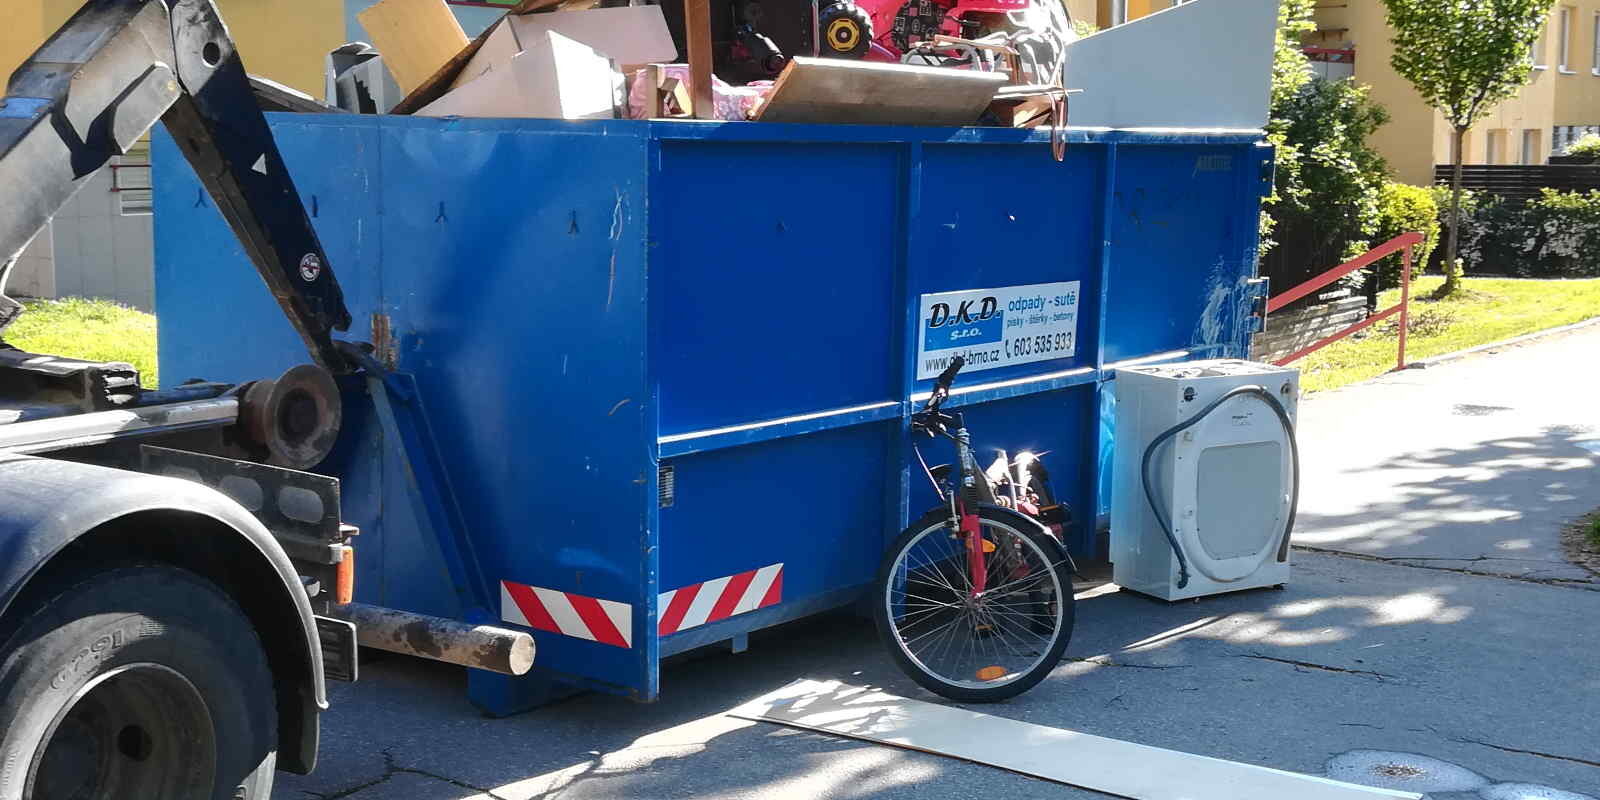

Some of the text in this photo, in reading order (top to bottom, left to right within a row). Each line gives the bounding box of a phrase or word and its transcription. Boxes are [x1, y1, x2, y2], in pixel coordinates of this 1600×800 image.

[930, 296, 1000, 328] D.K.D.
[1008, 294, 1045, 314] odpady
[1054, 290, 1075, 306] sutě
[950, 328, 982, 340] s.r.o.
[1014, 332, 1071, 356] 603 535 933
[925, 350, 1000, 371] www.d-brno.cz
